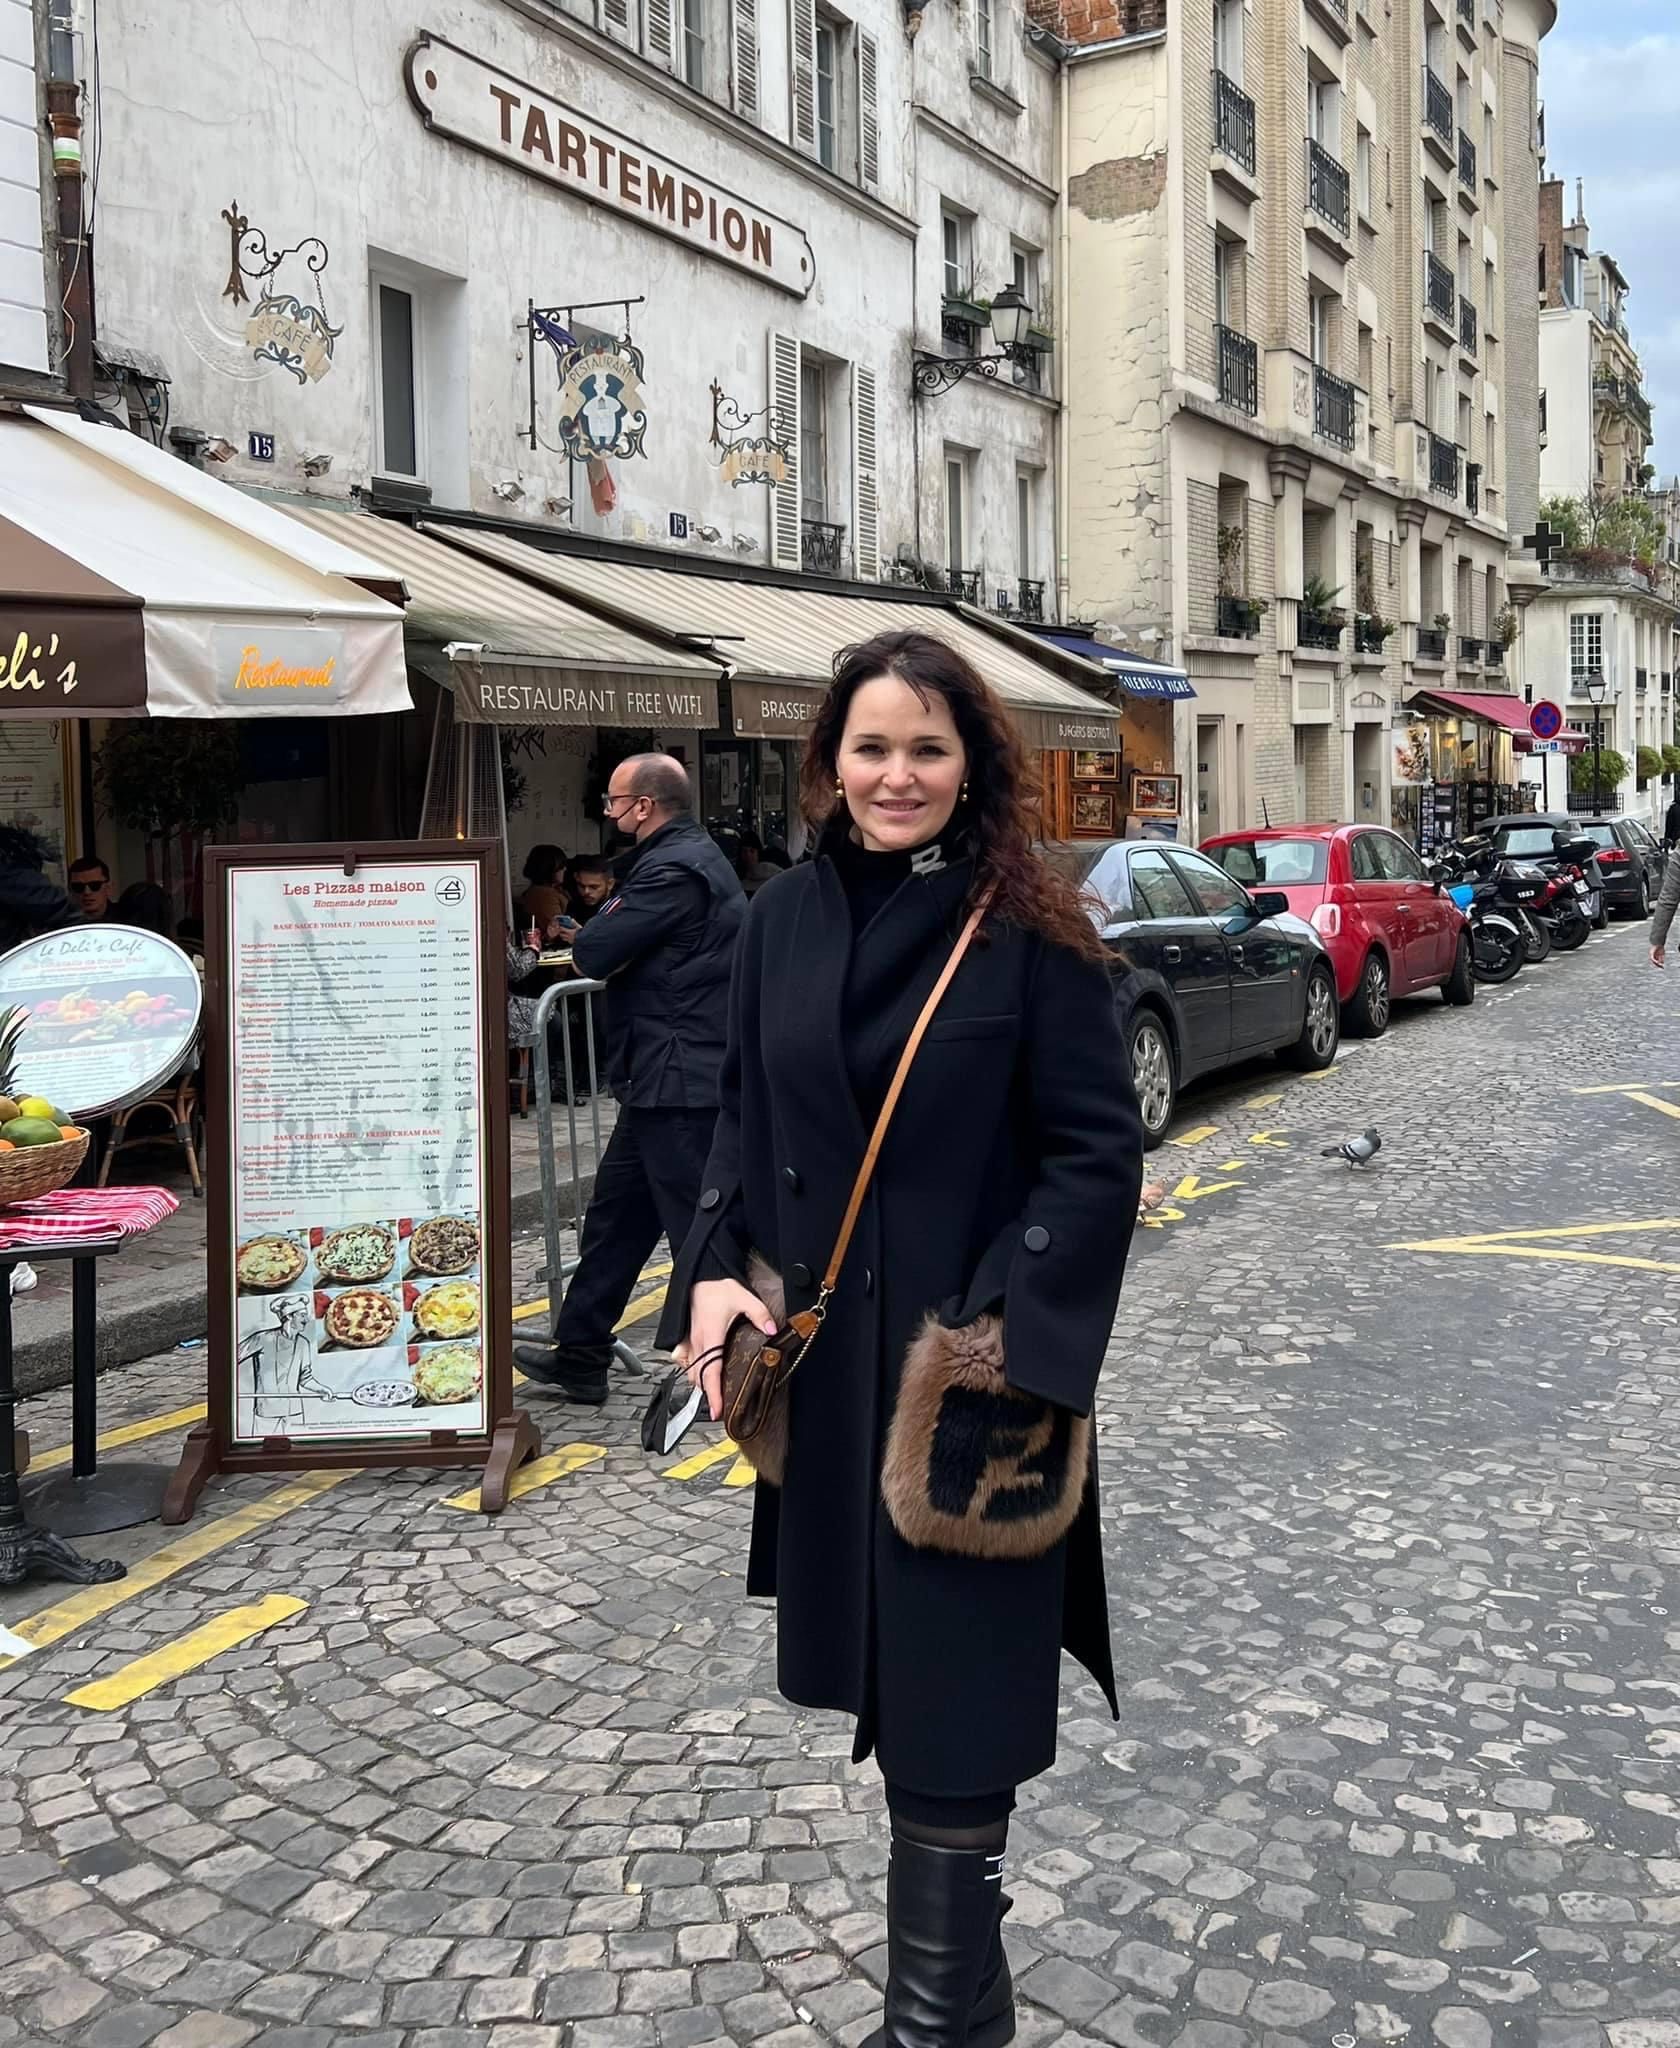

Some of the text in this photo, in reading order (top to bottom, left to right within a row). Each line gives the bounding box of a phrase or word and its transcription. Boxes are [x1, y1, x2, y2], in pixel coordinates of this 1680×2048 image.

[490, 84, 772, 267] TARTEMPION
[253, 435, 272, 458] 15
[673, 514, 685, 536] 15
[234, 645, 336, 690] Restaurant
[480, 685, 703, 716] RESTAURANT FREE WIFI
[1534, 743, 1551, 751] SAUF
[284, 880, 425, 895] Les Pizzas maison
[313, 898, 398, 908] Homemade pizzas
[40, 944, 54, 957] Le
[110, 938, 145, 956] Café
